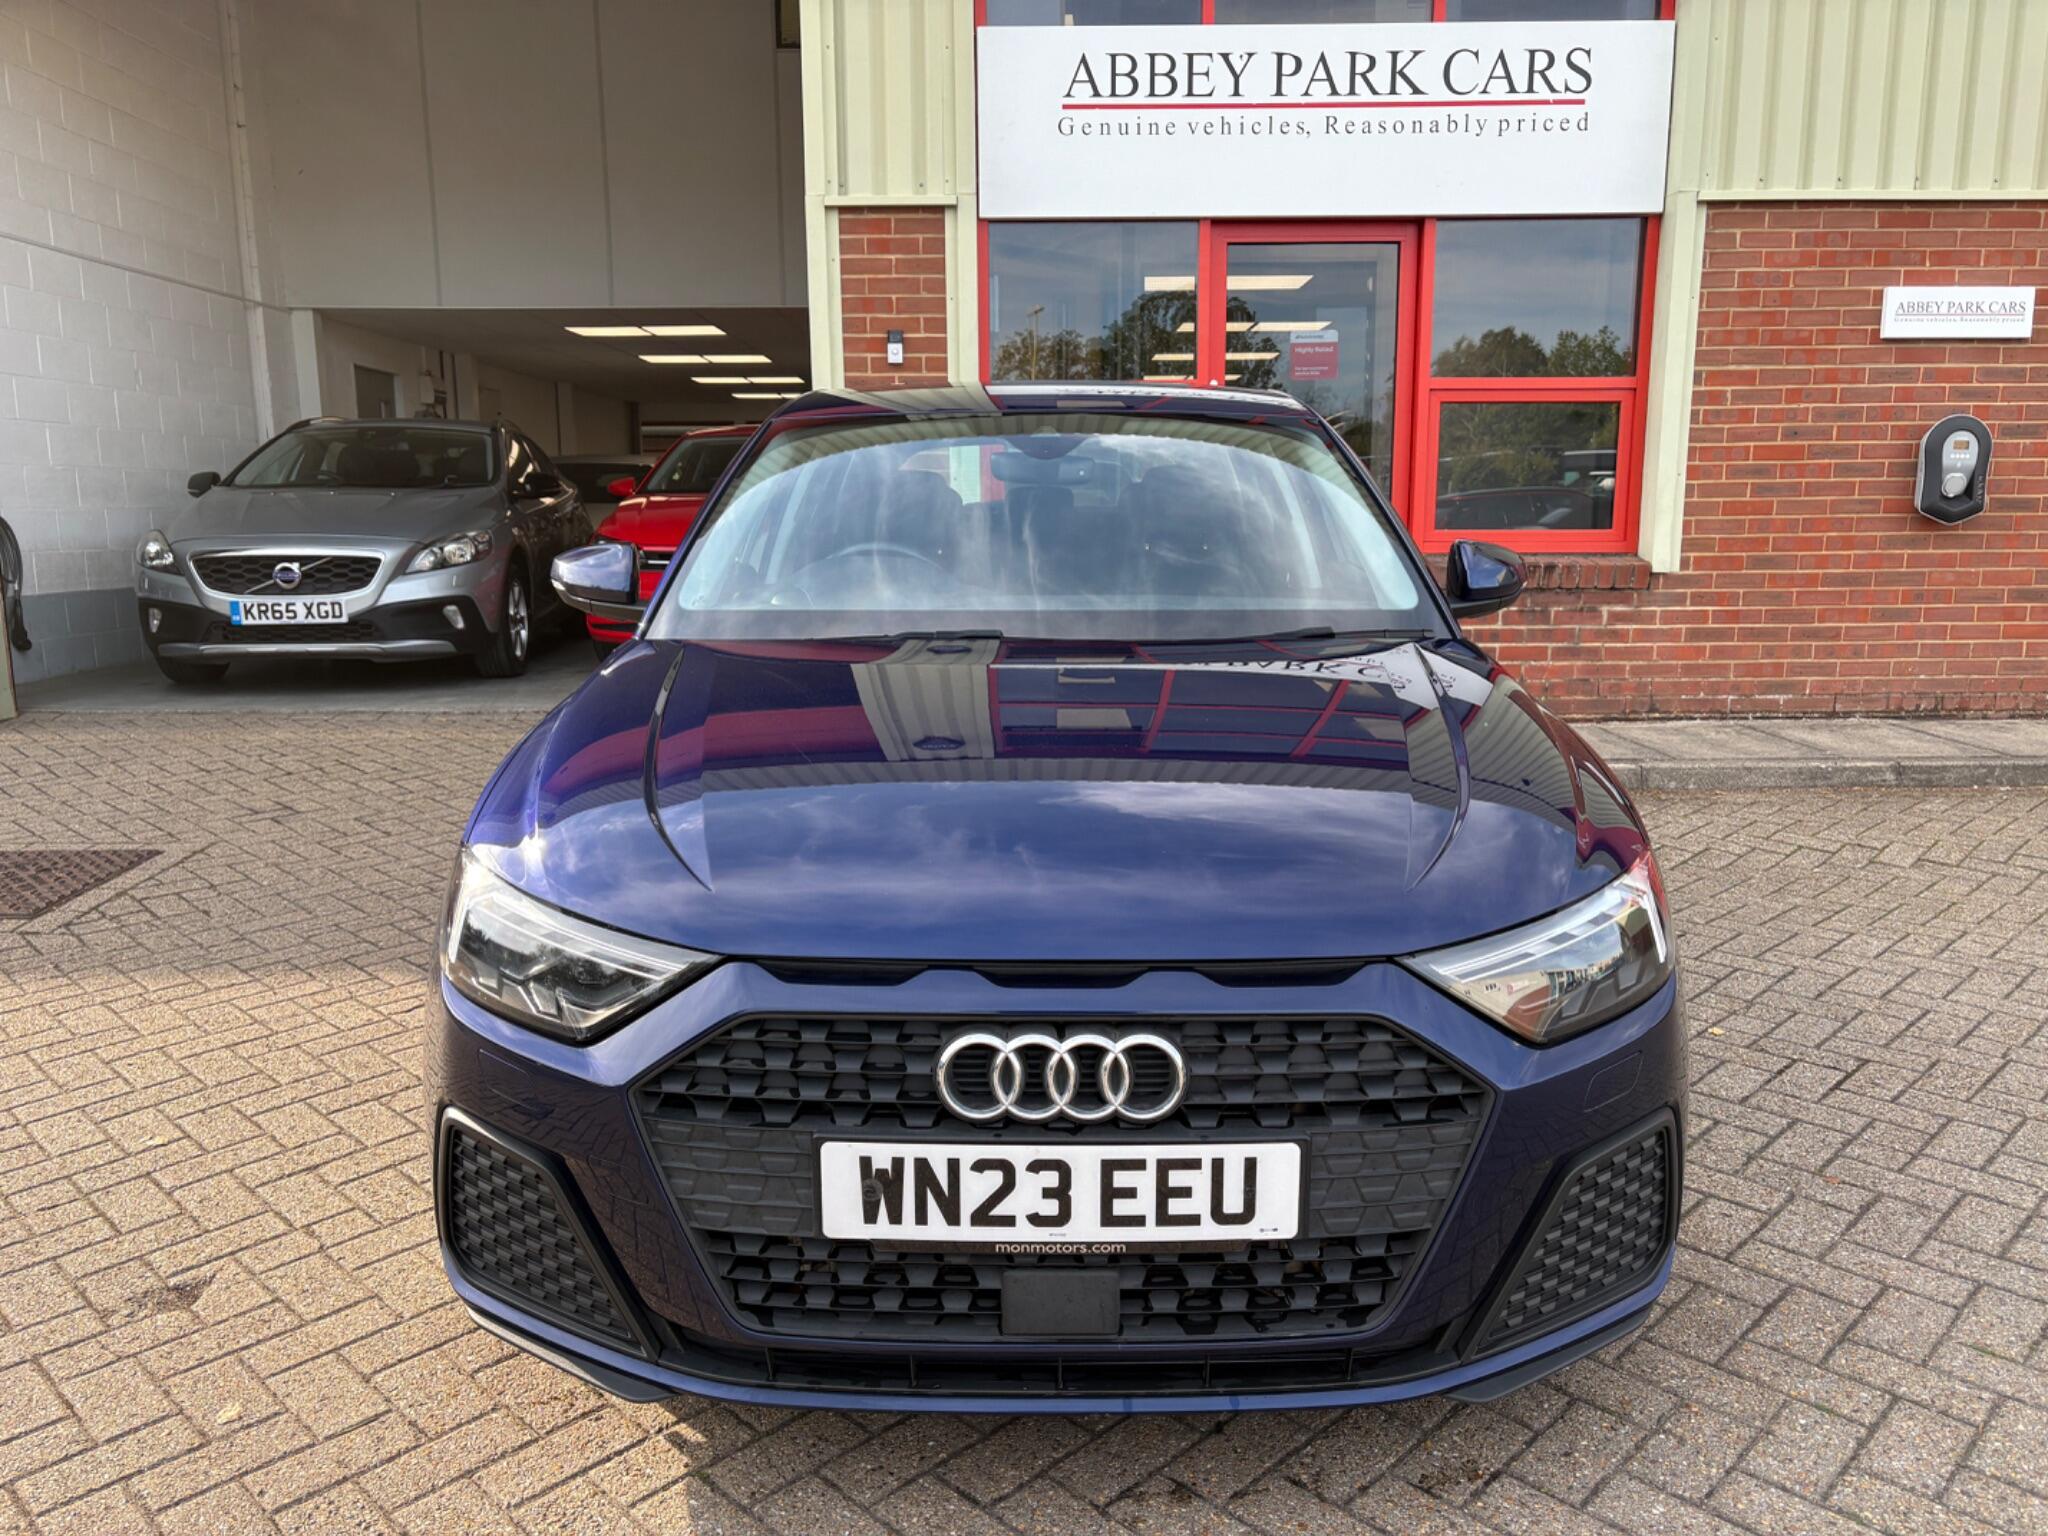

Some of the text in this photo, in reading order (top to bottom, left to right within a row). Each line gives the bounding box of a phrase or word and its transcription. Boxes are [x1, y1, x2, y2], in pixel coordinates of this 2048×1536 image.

[1062, 48, 1592, 98] ABBEY PARK CARS
[1057, 112, 1590, 138] Genuine vehicles, Reasonably priced
[1895, 301, 2027, 314] ABBEY PARK CARS
[243, 601, 344, 621] KR65 XGD
[858, 1155, 1259, 1228] WN23 EEU
[995, 1241, 1127, 1254] monmotors.com
